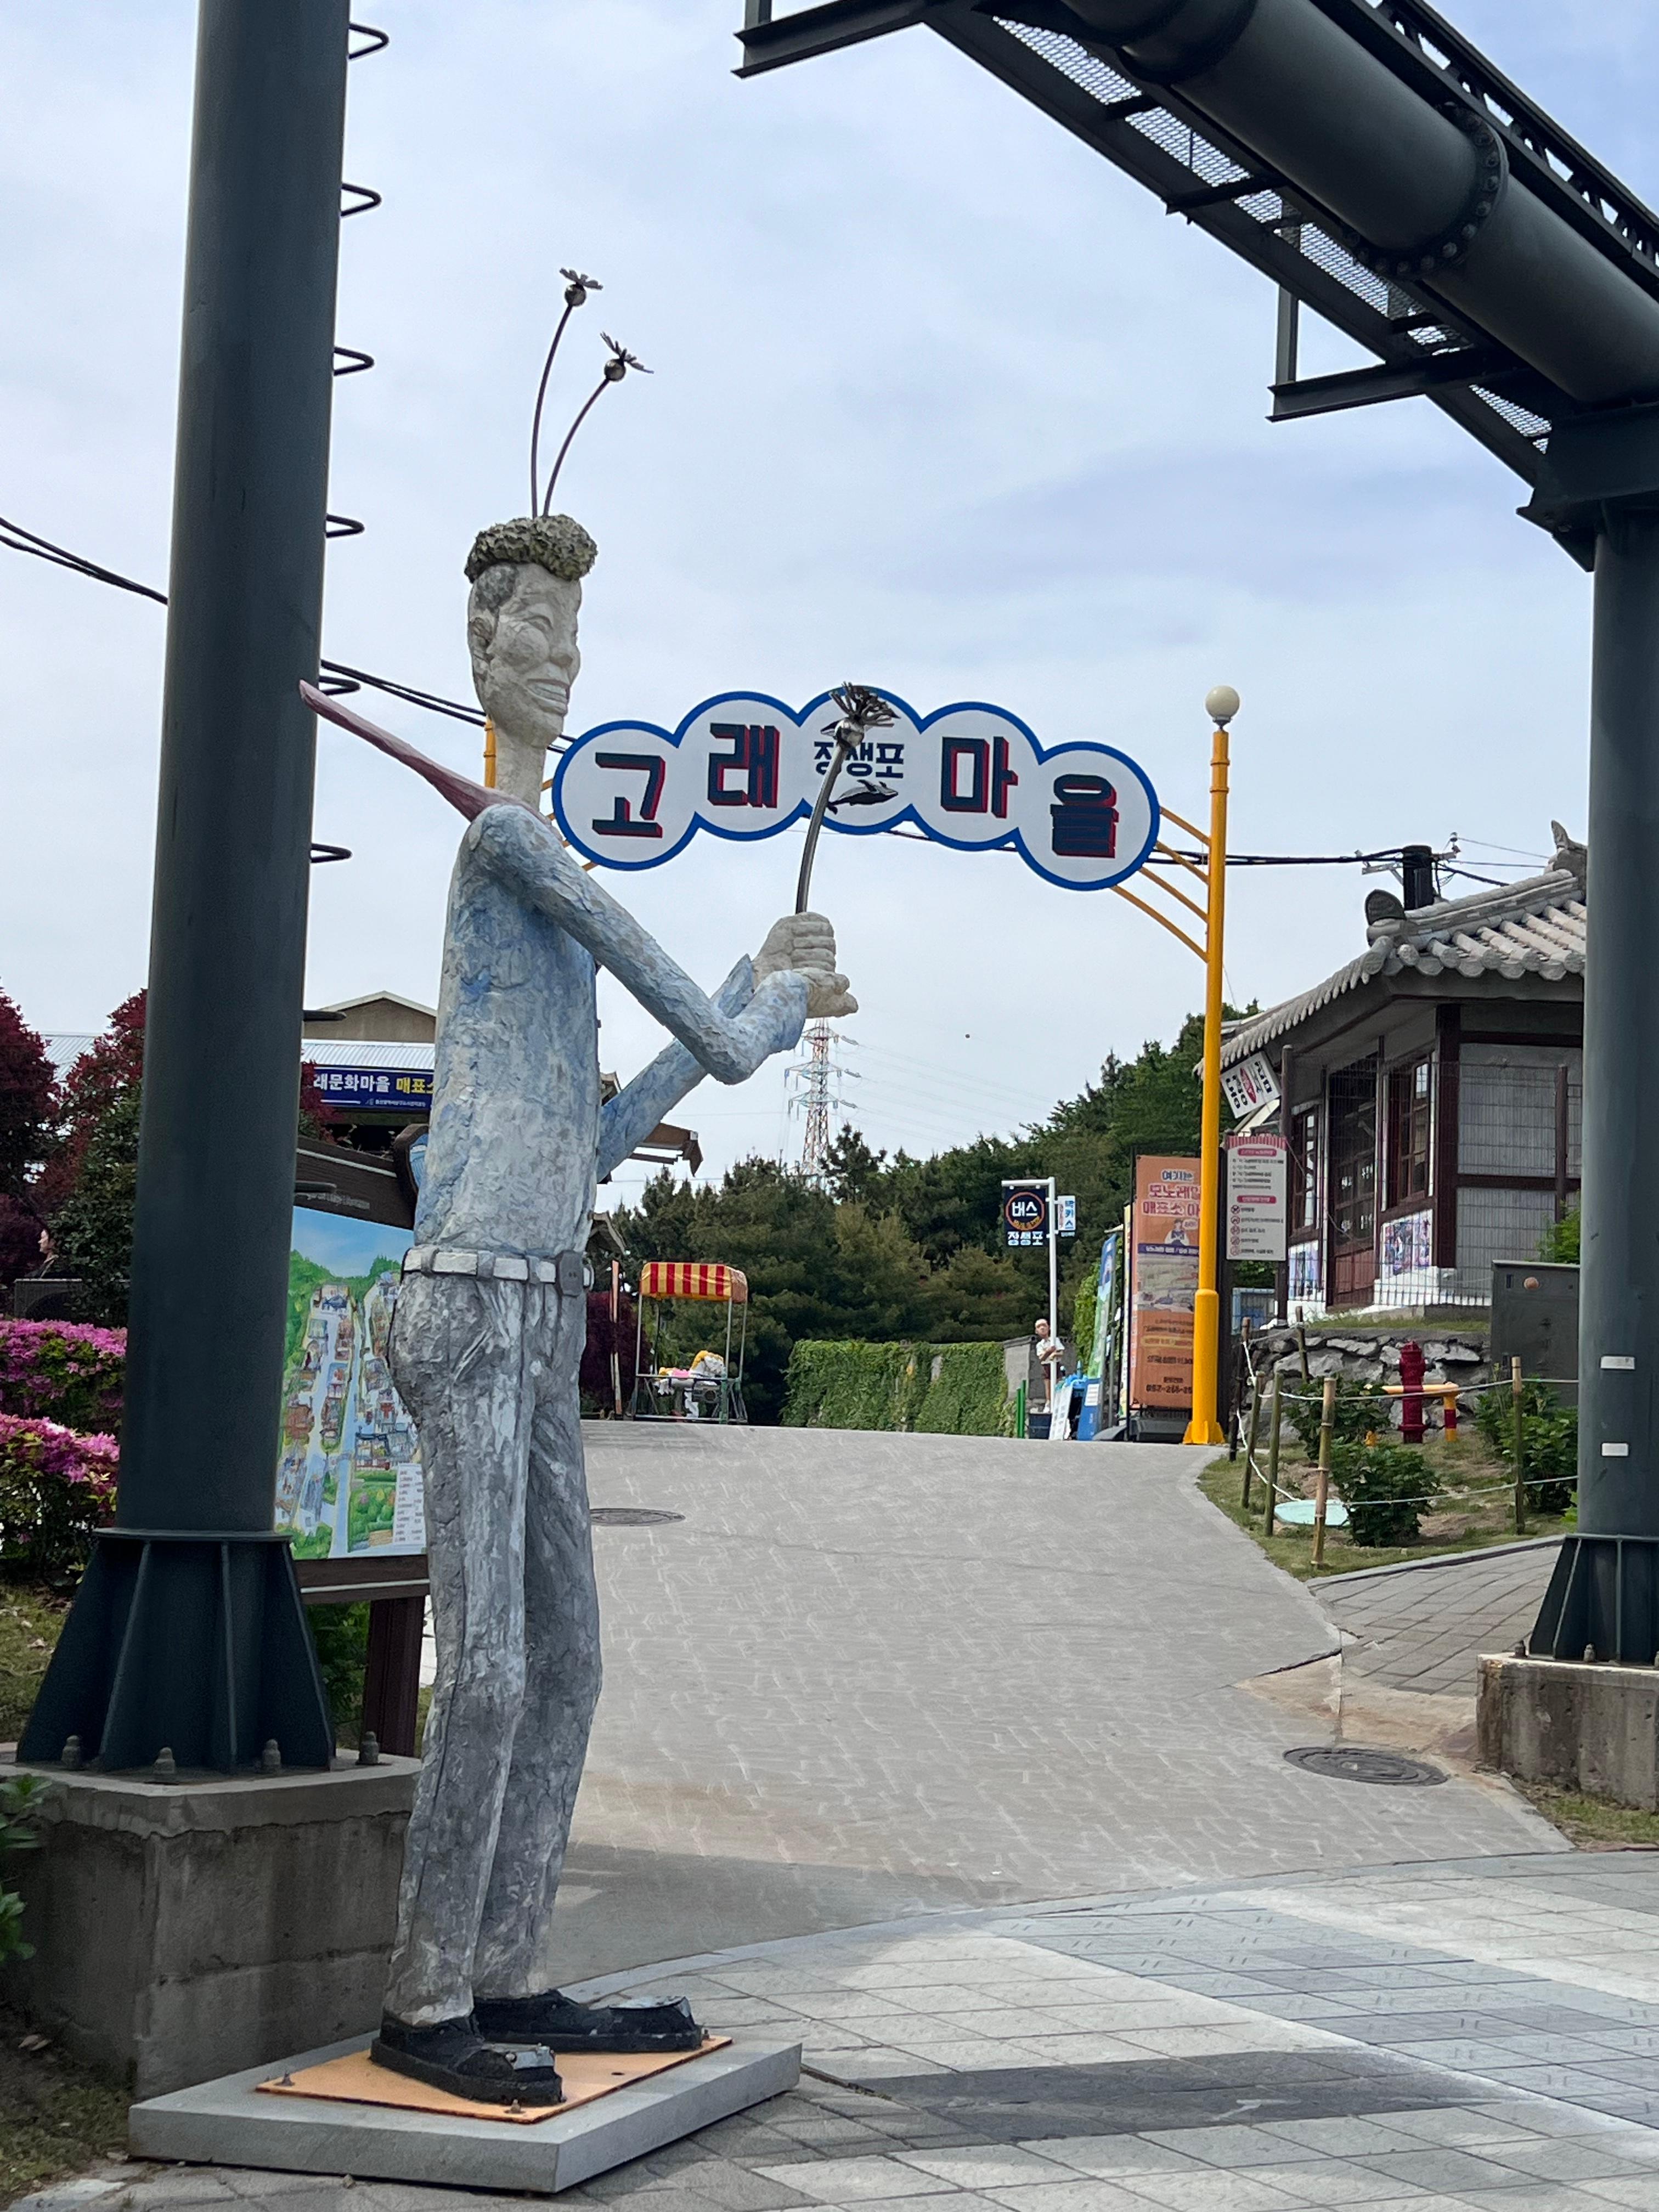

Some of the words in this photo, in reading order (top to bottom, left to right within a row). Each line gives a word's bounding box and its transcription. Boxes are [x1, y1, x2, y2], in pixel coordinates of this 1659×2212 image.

[592, 722, 780, 838] 고래
[940, 736, 1120, 858] 마을
[312, 1073, 391, 1093] 래문화마을
[1011, 1201, 1038, 1217] 버스
